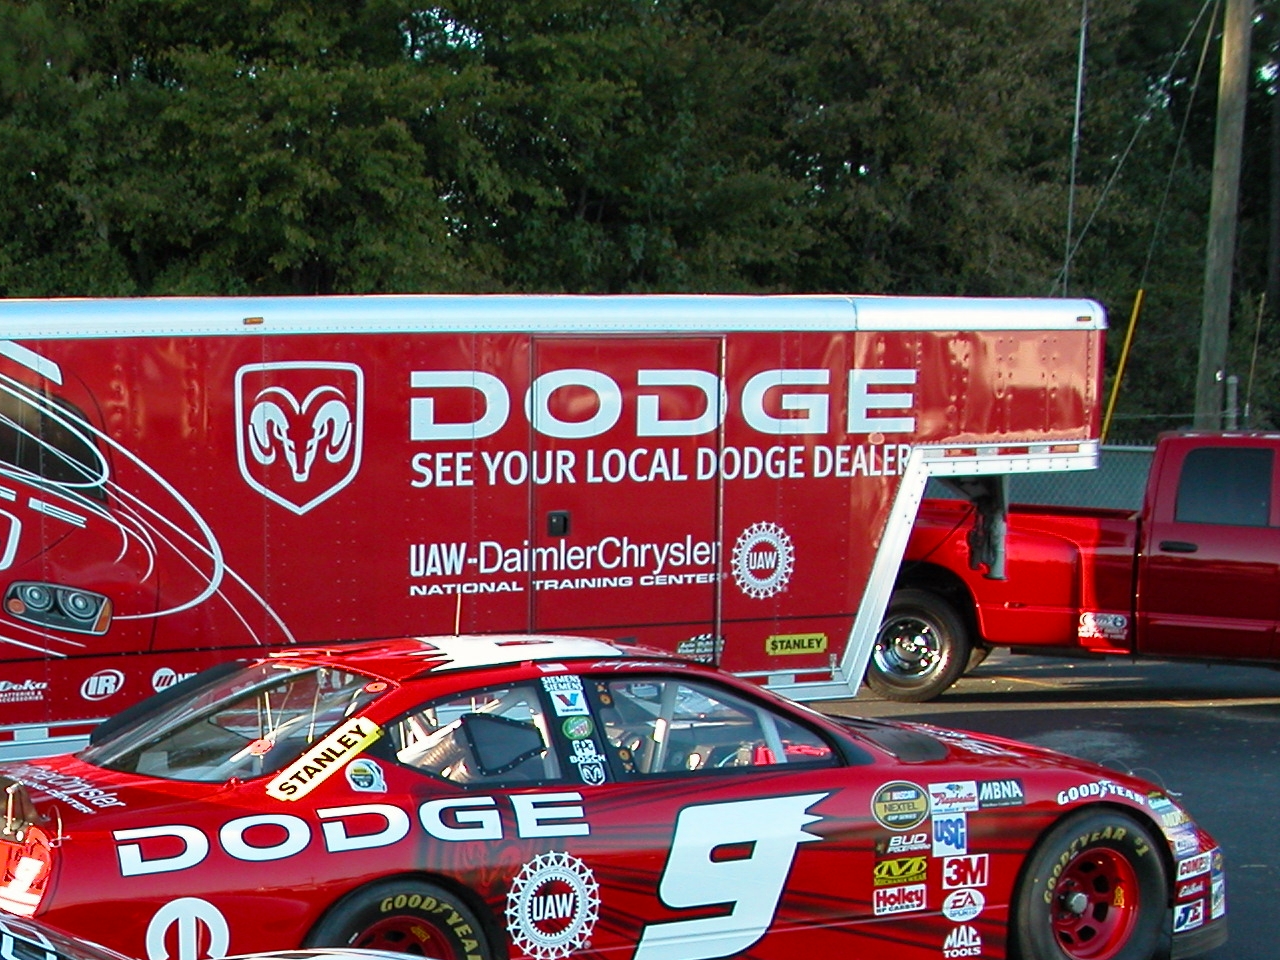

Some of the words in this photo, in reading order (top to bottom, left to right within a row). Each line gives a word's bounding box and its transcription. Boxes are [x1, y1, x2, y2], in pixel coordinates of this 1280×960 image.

[410, 368, 918, 441] DODGE
[410, 452, 474, 488] SEE
[481, 450, 577, 486] YOUR
[586, 446, 688, 483] LOCAL
[696, 445, 806, 481] DODGE
[813, 443, 912, 479] DEALER
[409, 534, 722, 577] UAW-DaimlerChrysler
[749, 550, 778, 570] UAW
[409, 581, 524, 596] NATIONAL
[532, 576, 634, 591] TRAINING
[639, 572, 721, 587] CENTER
[770, 637, 824, 652] STANLEY
[278, 723, 369, 796] STANLEY
[569, 754, 607, 764] BOSCH
[979, 780, 1024, 801] MBNA
[1056, 779, 1145, 806] GOODYEAR
[112, 791, 592, 878] DODGE
[889, 833, 927, 847] BUD
[933, 818, 966, 850] USG
[944, 856, 985, 887] 3M
[1043, 826, 1127, 904] GOODYEAR
[532, 892, 575, 922] UAW
[876, 886, 924, 908] Holley
[950, 891, 977, 910] EA
[943, 925, 981, 949] MAC
[944, 946, 981, 958] TOOLS
